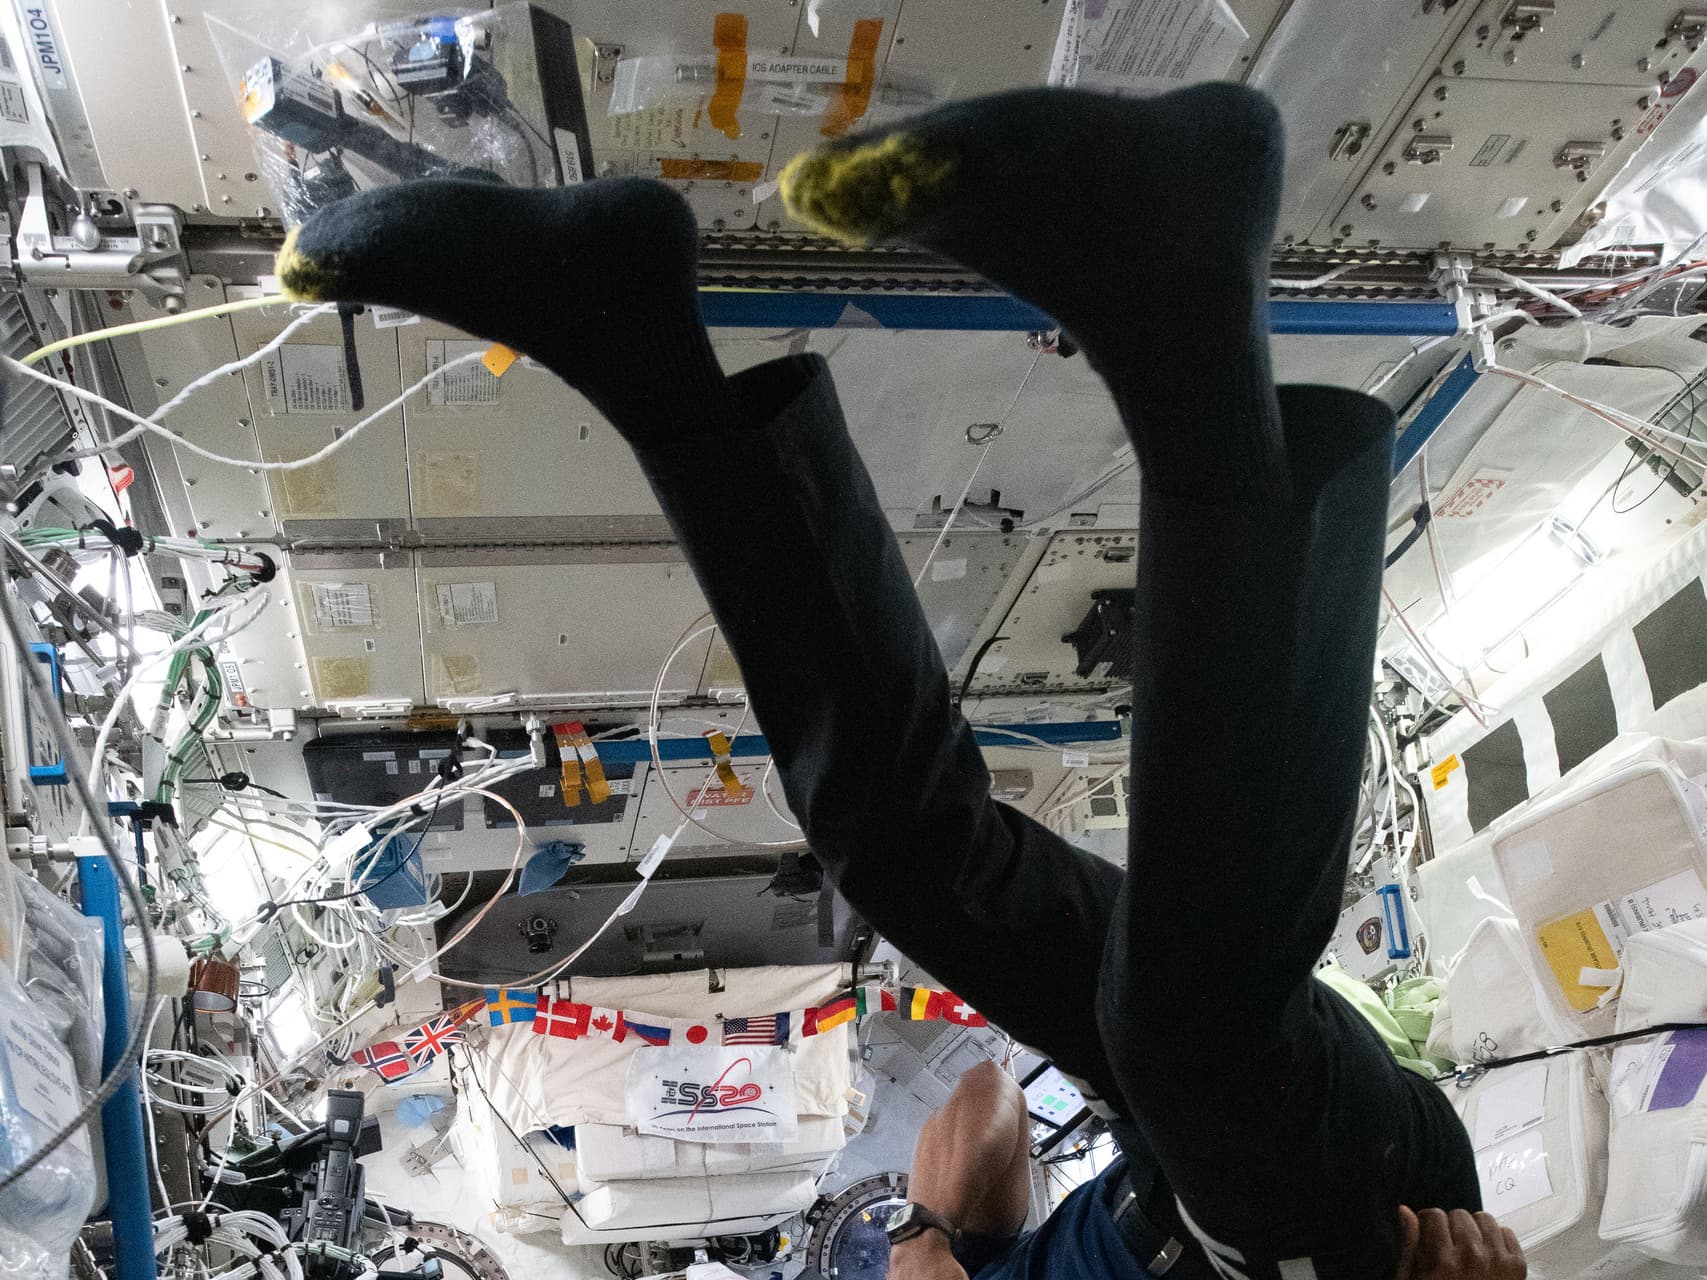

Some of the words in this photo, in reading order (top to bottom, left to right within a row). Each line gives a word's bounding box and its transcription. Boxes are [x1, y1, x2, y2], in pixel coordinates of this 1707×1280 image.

[752, 63, 767, 72] ICS
[769, 63, 809, 74] ADAPTER
[810, 65, 838, 75] CABLE
[697, 1124, 735, 1132] International
